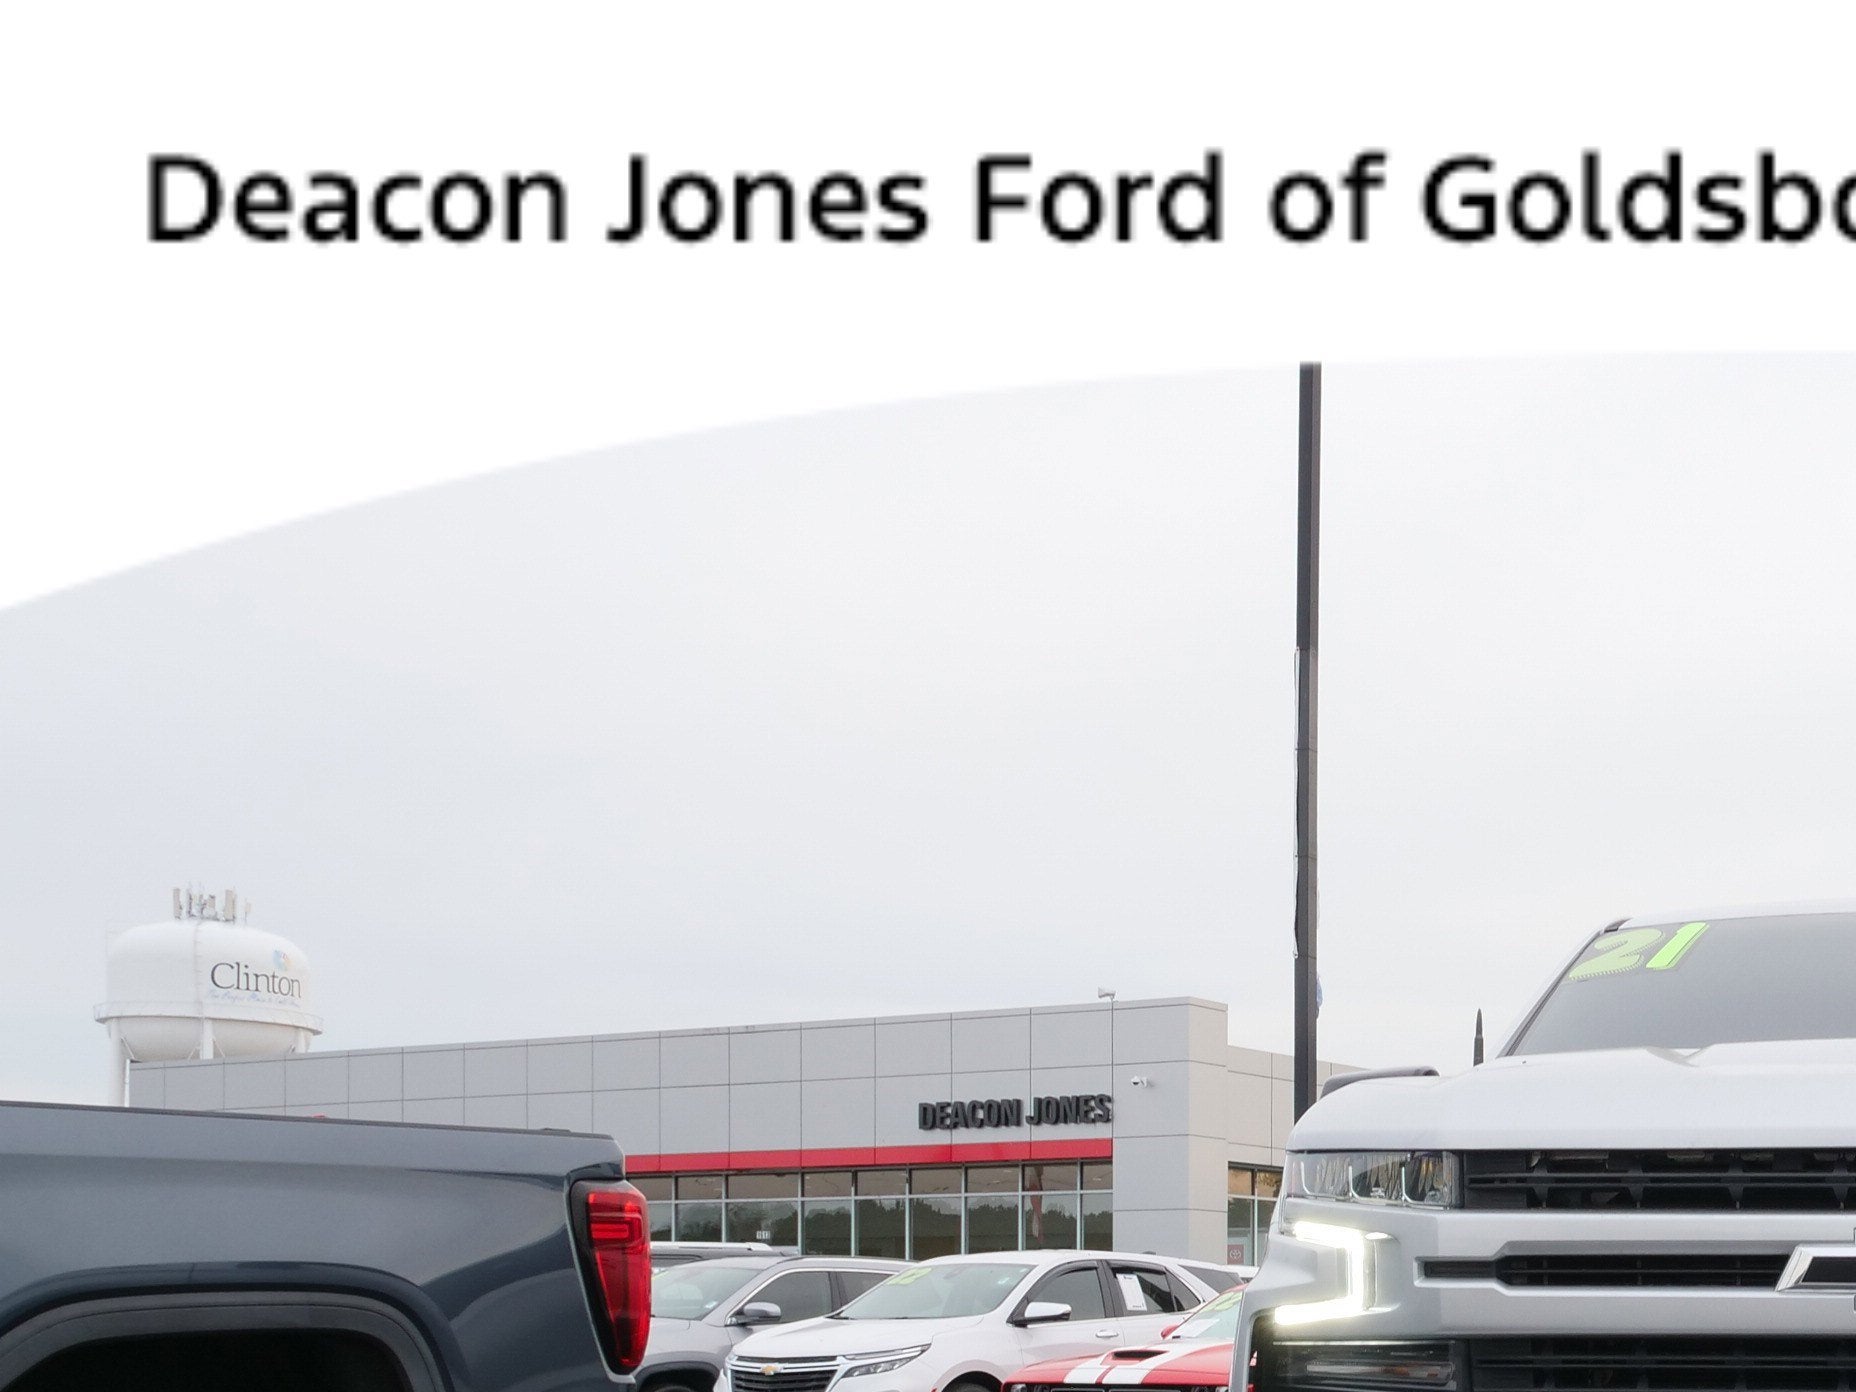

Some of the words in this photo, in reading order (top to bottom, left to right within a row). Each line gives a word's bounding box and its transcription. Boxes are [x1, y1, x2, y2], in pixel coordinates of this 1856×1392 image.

[1569, 922, 1709, 981] 21
[210, 961, 302, 998] Clinton
[918, 1098, 1023, 1130] DEACON
[1025, 1093, 1113, 1126] JONES
